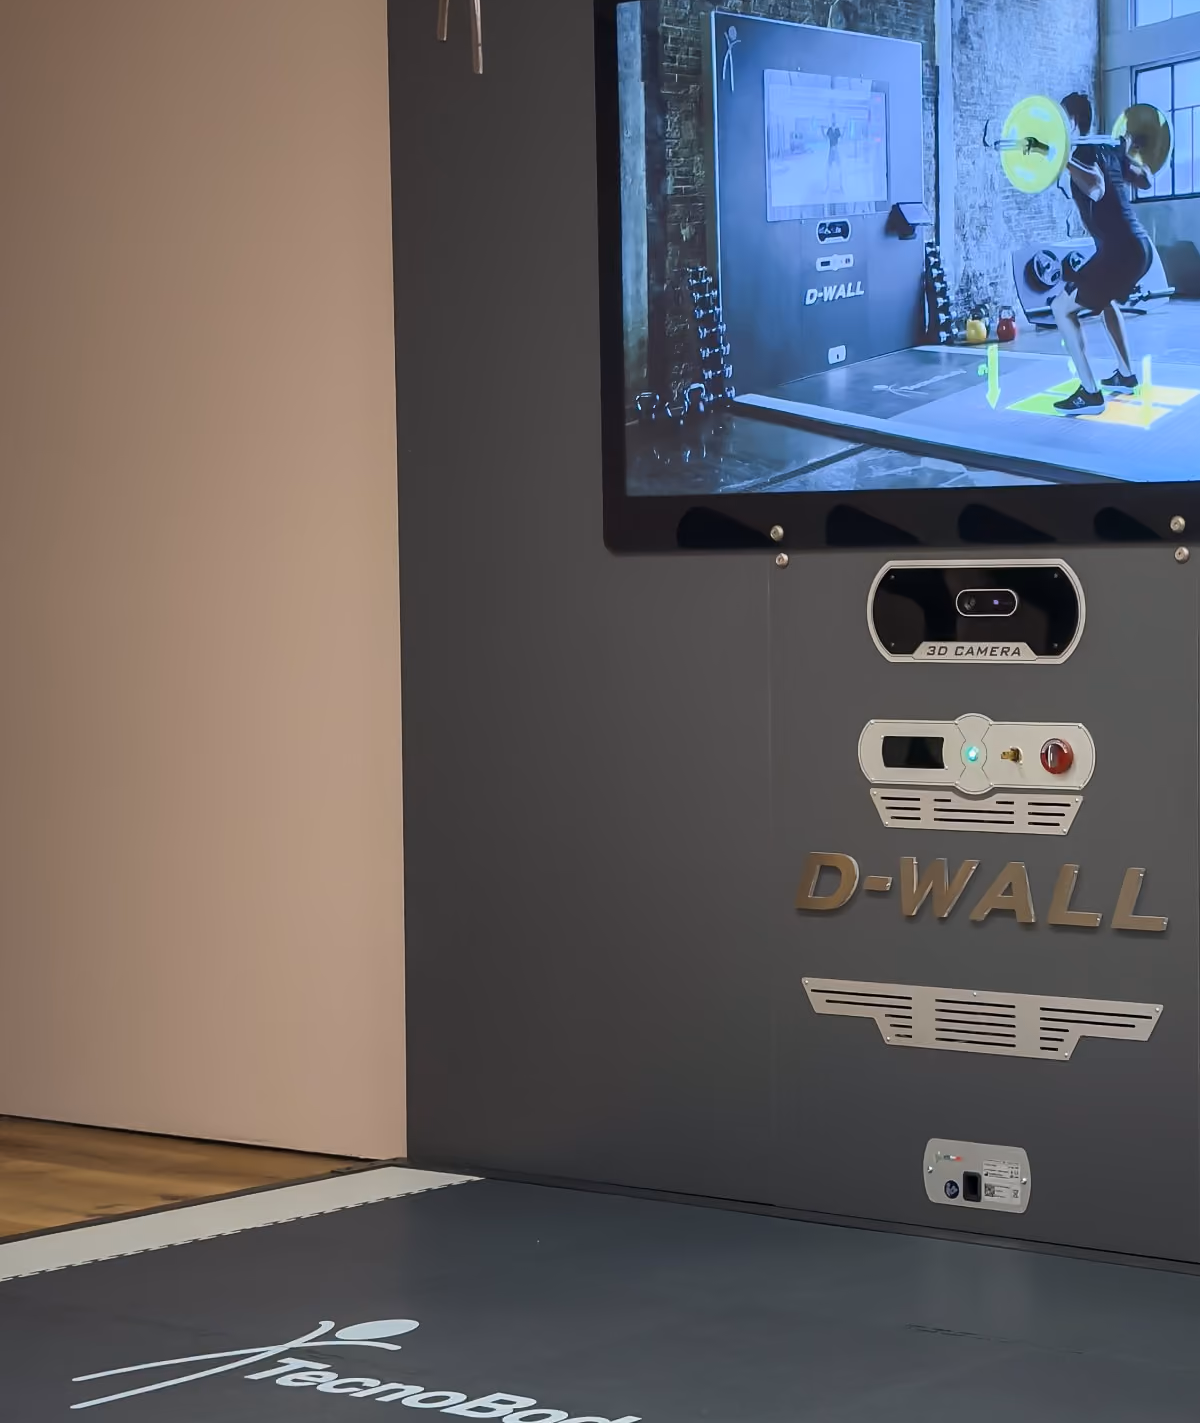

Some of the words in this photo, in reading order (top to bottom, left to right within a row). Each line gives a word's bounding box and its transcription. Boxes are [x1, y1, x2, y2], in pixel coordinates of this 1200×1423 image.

[805, 280, 865, 305] D-WALL
[926, 645, 948, 656] 3D
[954, 646, 1021, 657] CAMERA
[795, 851, 1169, 931] D-WALL
